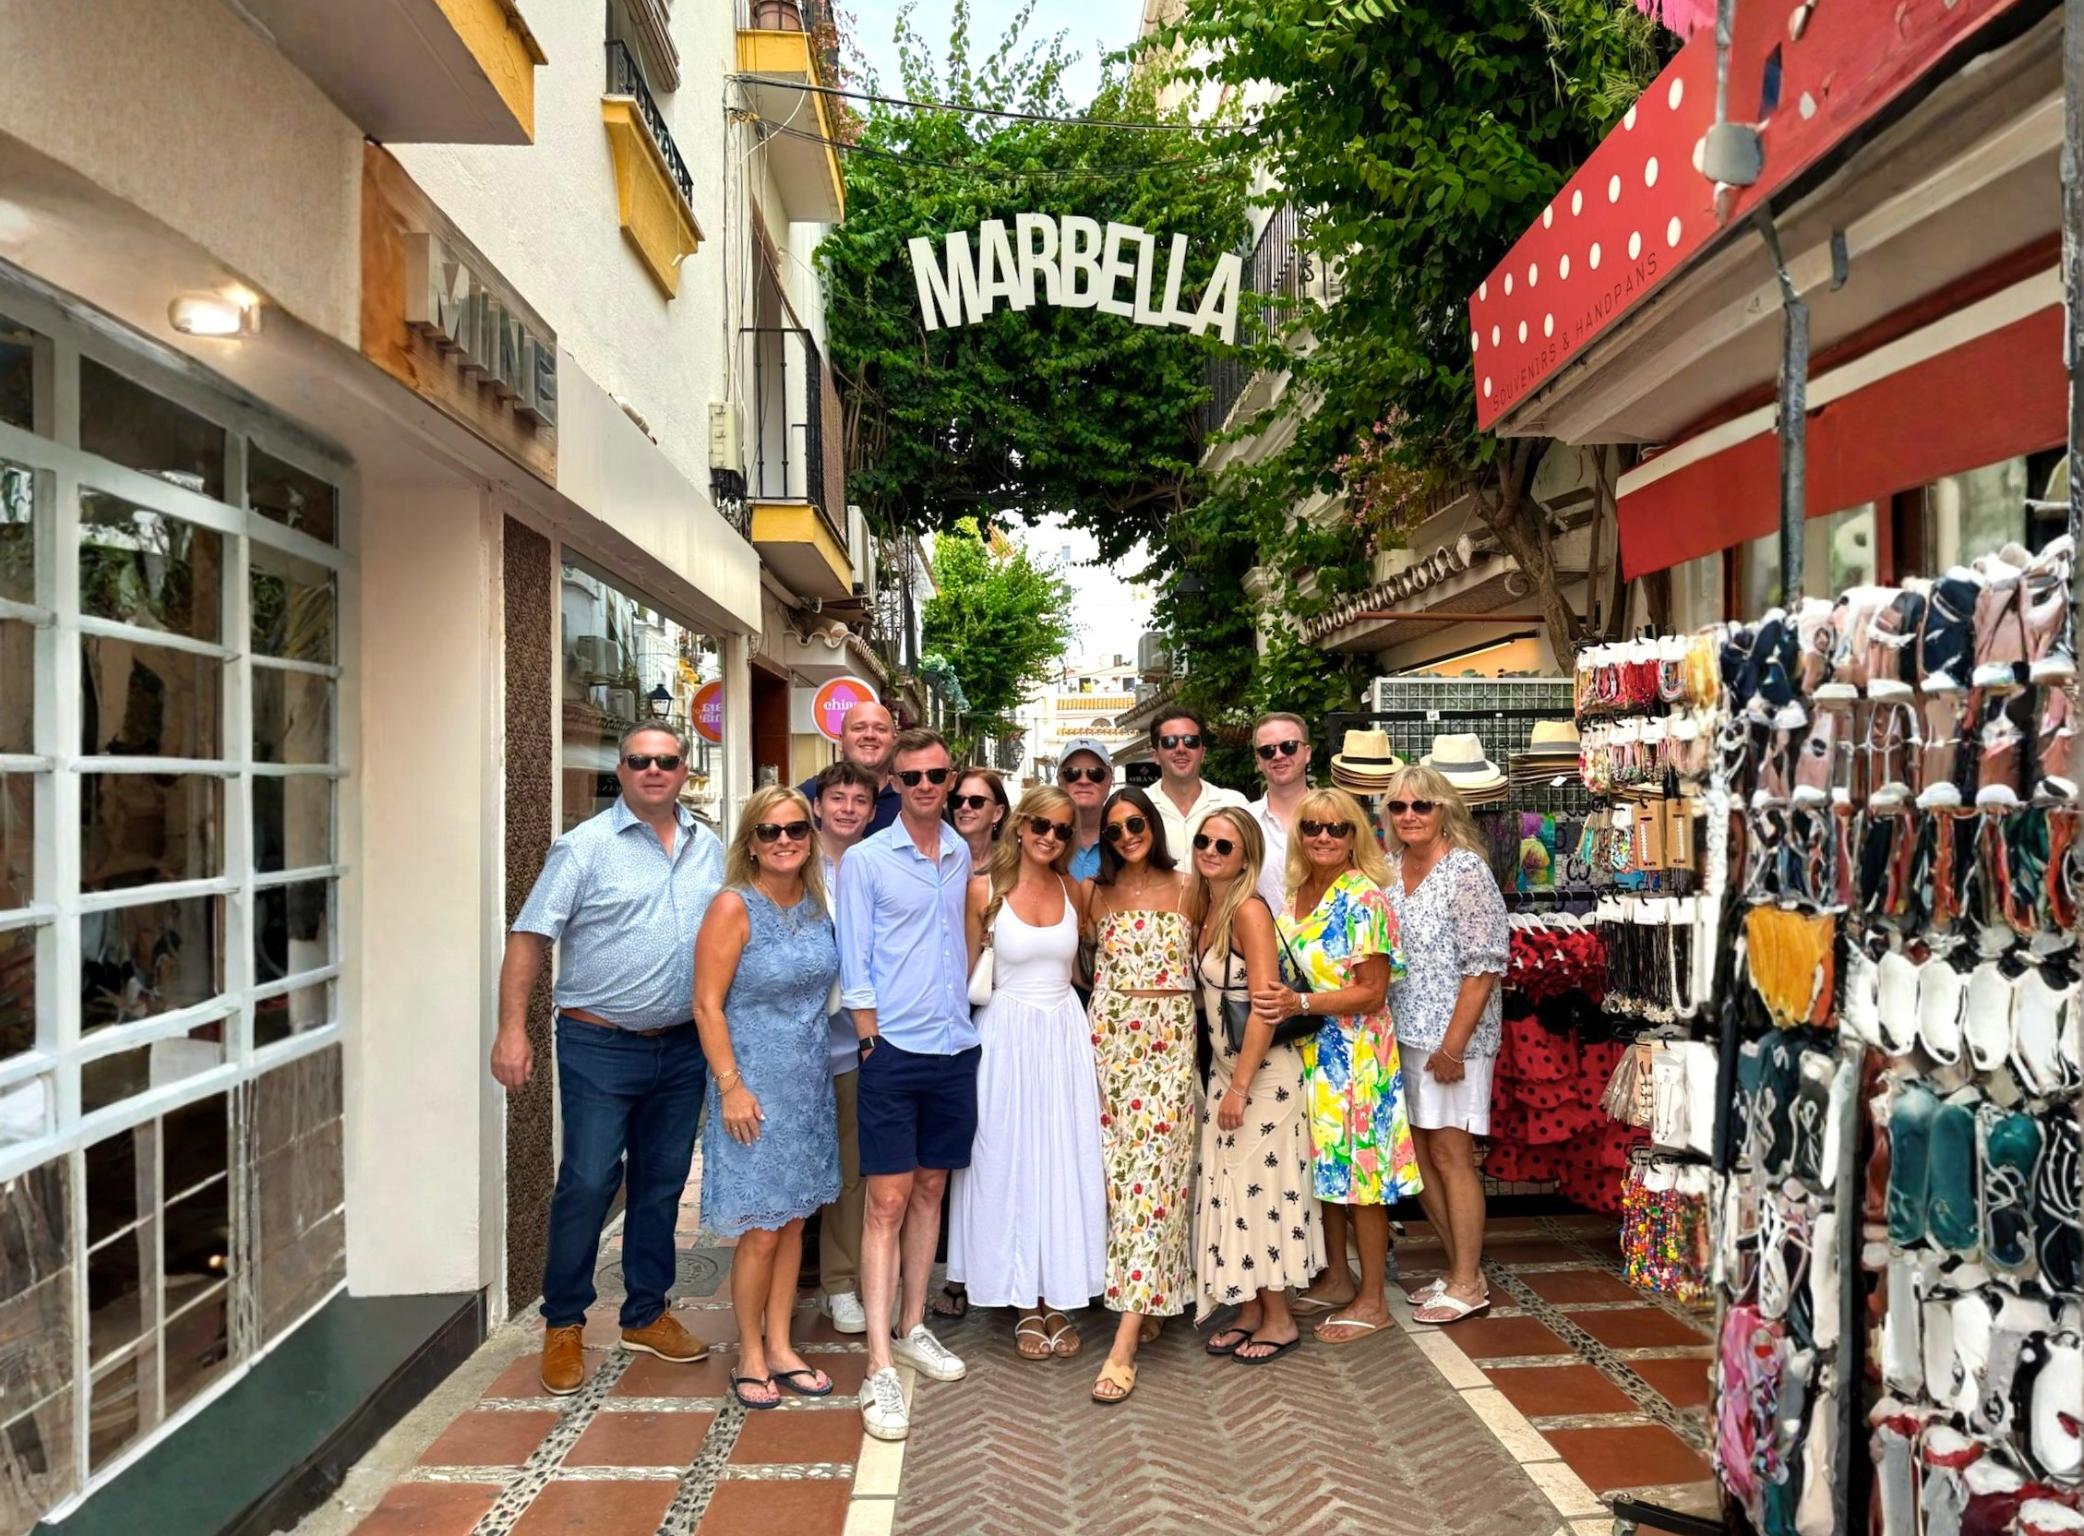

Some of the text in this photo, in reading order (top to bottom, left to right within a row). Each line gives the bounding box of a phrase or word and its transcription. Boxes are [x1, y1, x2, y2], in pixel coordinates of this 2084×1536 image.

[404, 232, 556, 427] MINE
[908, 212, 1243, 346] MARBELLA
[1492, 252, 1658, 412] SOUVENIRS & HANDPANS
